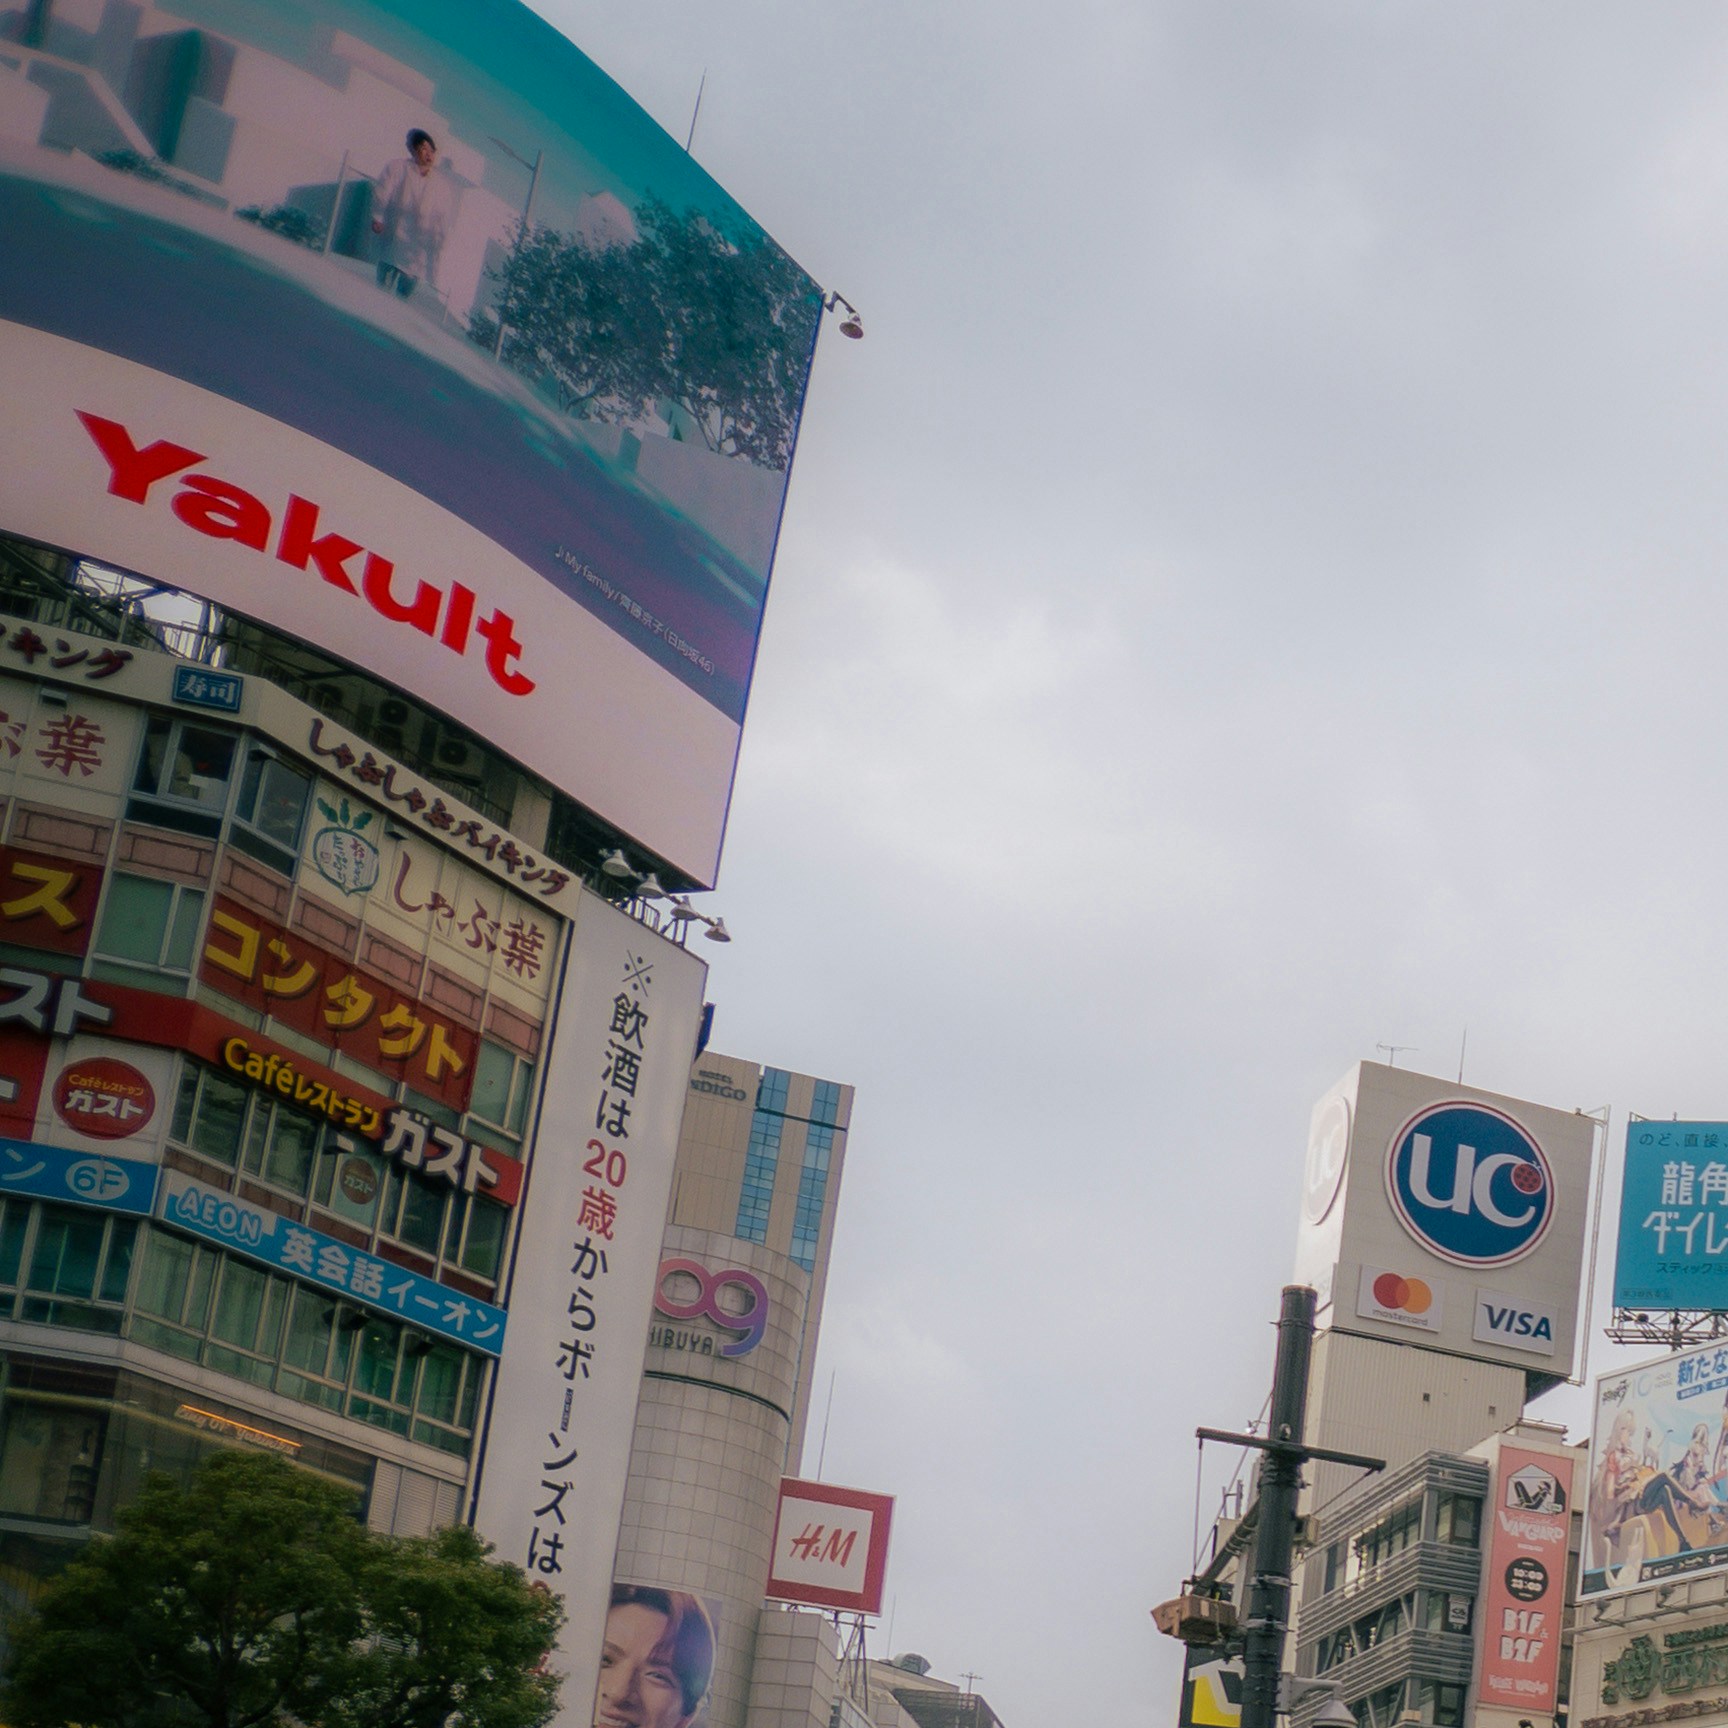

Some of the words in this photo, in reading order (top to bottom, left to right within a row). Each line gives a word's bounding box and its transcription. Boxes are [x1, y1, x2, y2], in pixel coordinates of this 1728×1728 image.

[74, 408, 536, 697] Yakult
[181, 675, 236, 705] 寿司
[309, 717, 570, 895] しゃぶしゃぶバイキング
[394, 850, 546, 979] しゃぶ葉
[206, 909, 464, 1078] コンタクト
[65, 1089, 144, 1120] ガスト
[383, 1109, 498, 1192] ガスト
[178, 1188, 263, 1241] AEON
[1480, 1302, 1553, 1341] VISA
[789, 1522, 859, 1569] H&M
